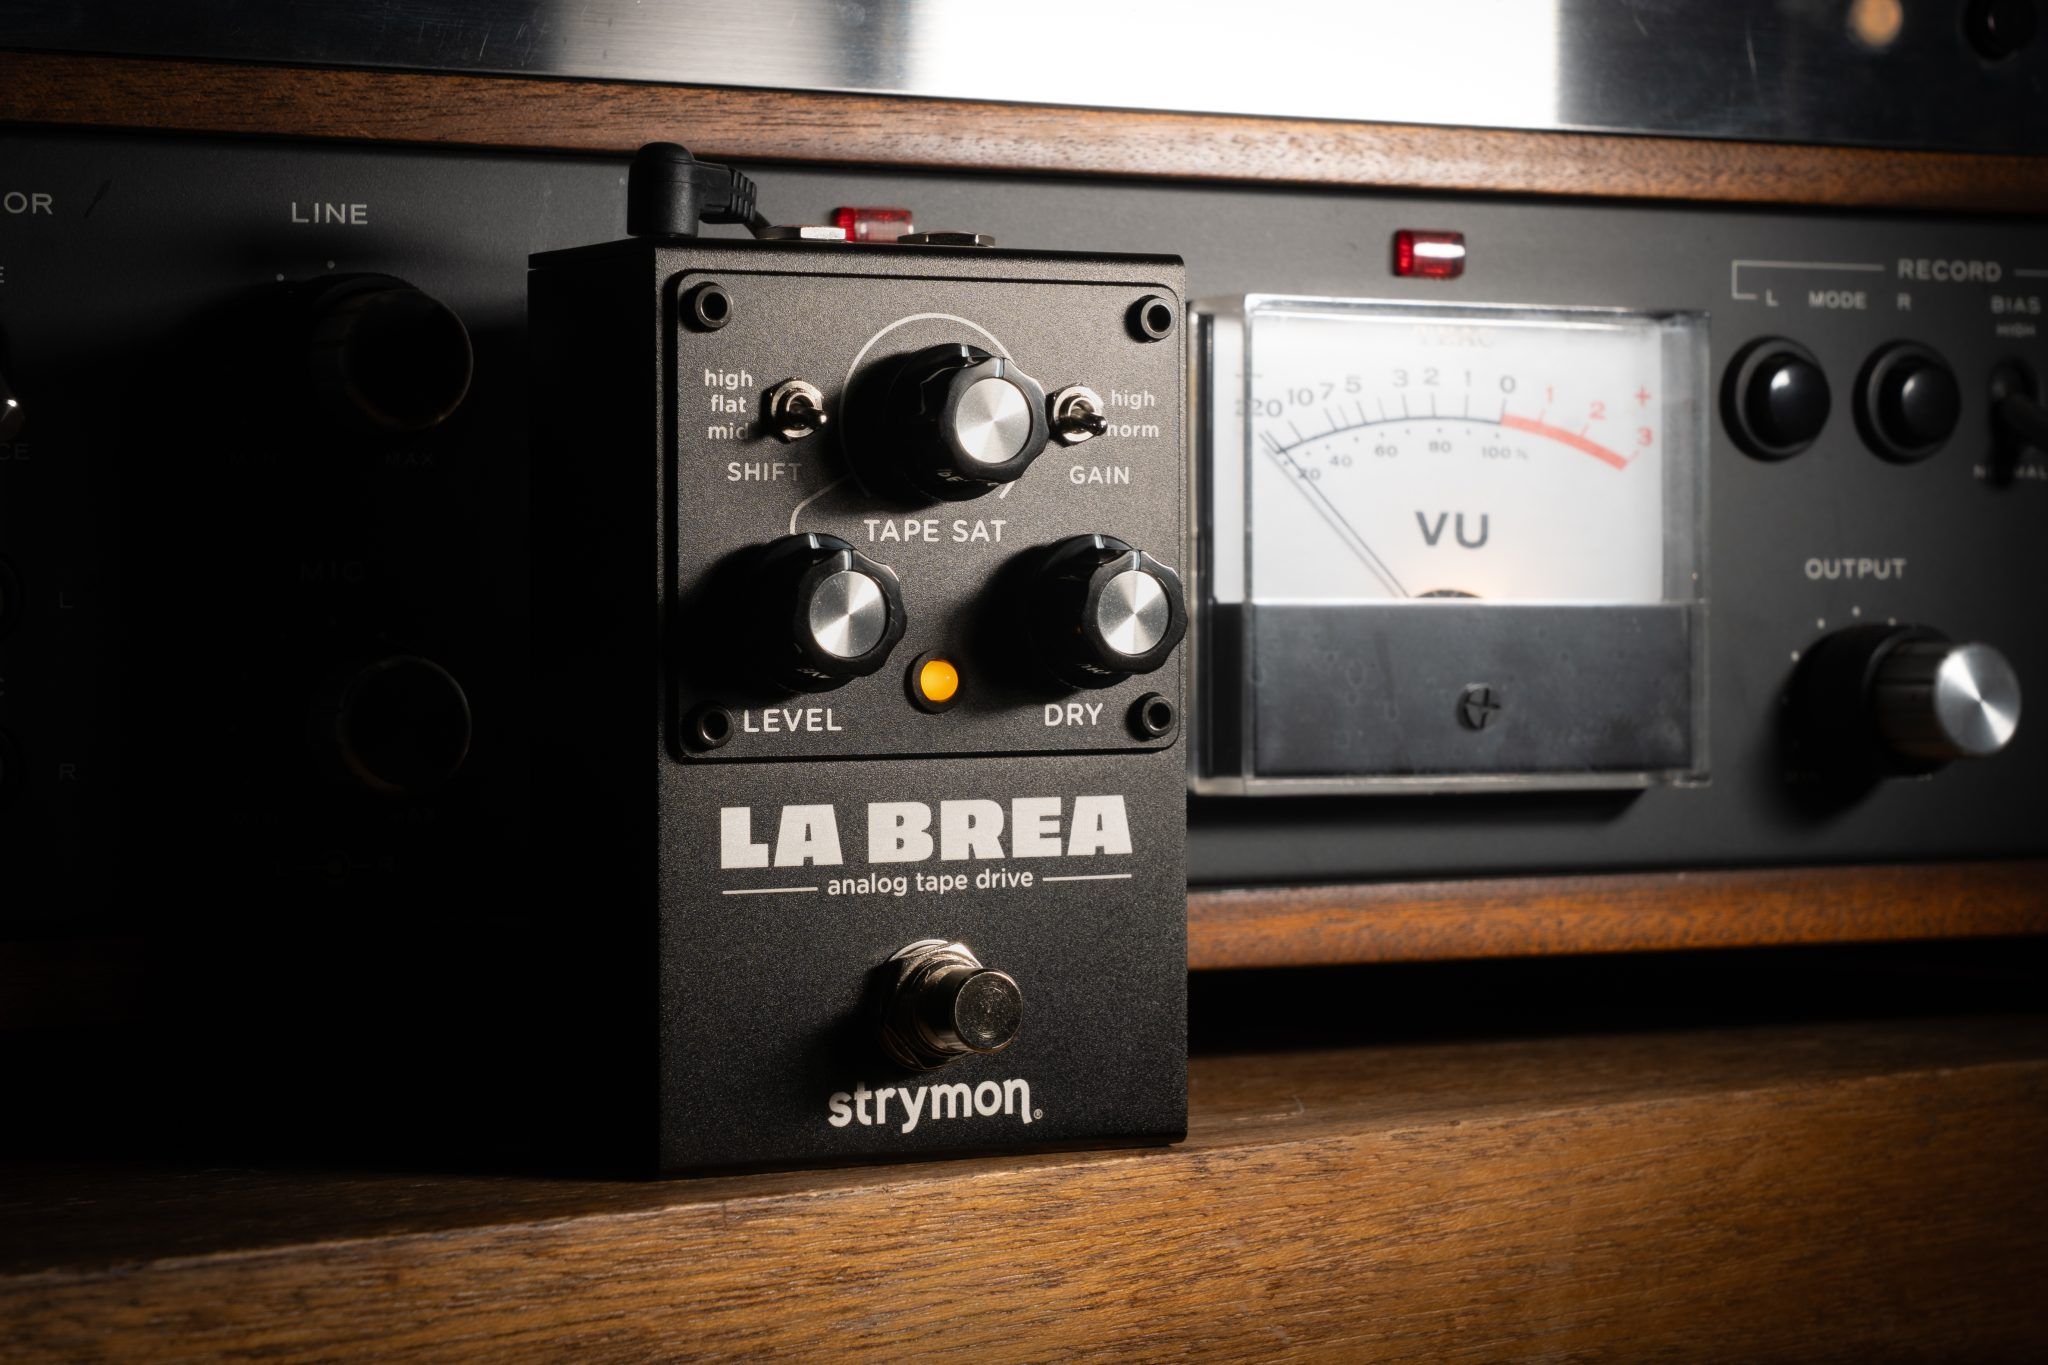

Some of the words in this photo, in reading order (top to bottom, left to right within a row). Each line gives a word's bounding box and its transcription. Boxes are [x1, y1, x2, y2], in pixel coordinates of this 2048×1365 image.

[4, 191, 53, 215] OR
[291, 201, 368, 225] LINE
[1897, 258, 2002, 282] RECORD
[1765, 289, 1779, 307] L
[1808, 291, 1867, 310] MODE
[1897, 293, 1912, 310] R
[1990, 295, 2042, 314] BIAS
[704, 369, 753, 391] high
[710, 394, 747, 413] flat
[1111, 389, 1155, 410] high
[1288, 387, 1314, 407] 10
[1319, 382, 1335, 400] 7
[1345, 375, 1362, 393] 5
[1392, 368, 1409, 388] 3
[1424, 367, 1440, 386] 2
[1500, 375, 1516, 394] 0
[1589, 401, 1606, 420] 2
[1637, 426, 1654, 447] 3
[1106, 423, 1160, 438] norm
[1330, 455, 1353, 467] 40
[1374, 445, 1399, 457] 60
[1428, 441, 1452, 453] 80
[727, 462, 802, 481] SHIFT
[1069, 465, 1130, 485] GAIN
[864, 519, 940, 542] TAPE
[952, 519, 1007, 542] SAT
[1414, 511, 1489, 549] VU
[1804, 558, 1907, 580] OUTPUT
[743, 708, 842, 732] LEVEL
[1044, 703, 1103, 726] DRY
[720, 804, 843, 869] LA
[868, 795, 1132, 863] BREA
[827, 872, 907, 898] analog
[917, 871, 968, 894] tape
[976, 868, 1034, 888] drive
